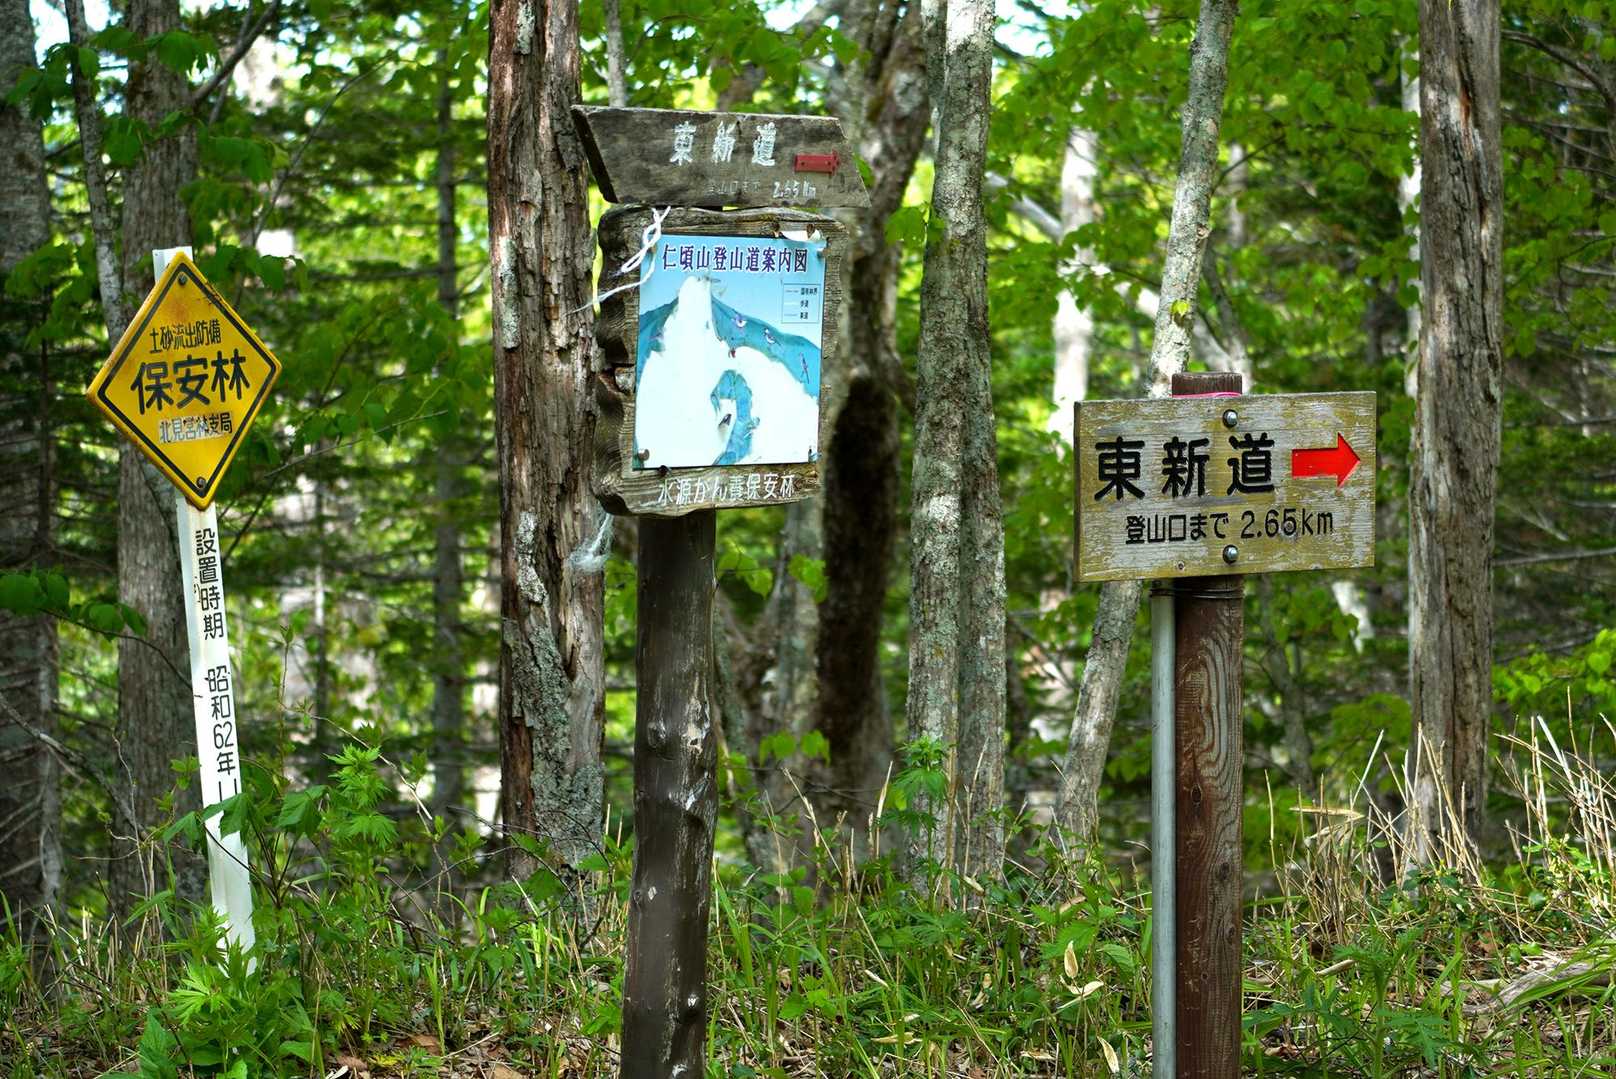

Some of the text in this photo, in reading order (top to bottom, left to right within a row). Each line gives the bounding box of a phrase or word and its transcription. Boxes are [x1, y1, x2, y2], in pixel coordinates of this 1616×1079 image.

[670, 121, 777, 166] 東新道
[663, 244, 808, 272] 仁頃山登山道案内図
[149, 319, 222, 354] 土砂流出防備
[131, 348, 250, 414] 保安林
[1094, 432, 1275, 500] 東新道
[658, 471, 796, 505] 水源かん養保安林
[1125, 508, 1334, 545] 登山口まで 2.65km
[195, 528, 225, 640] 設置時期
